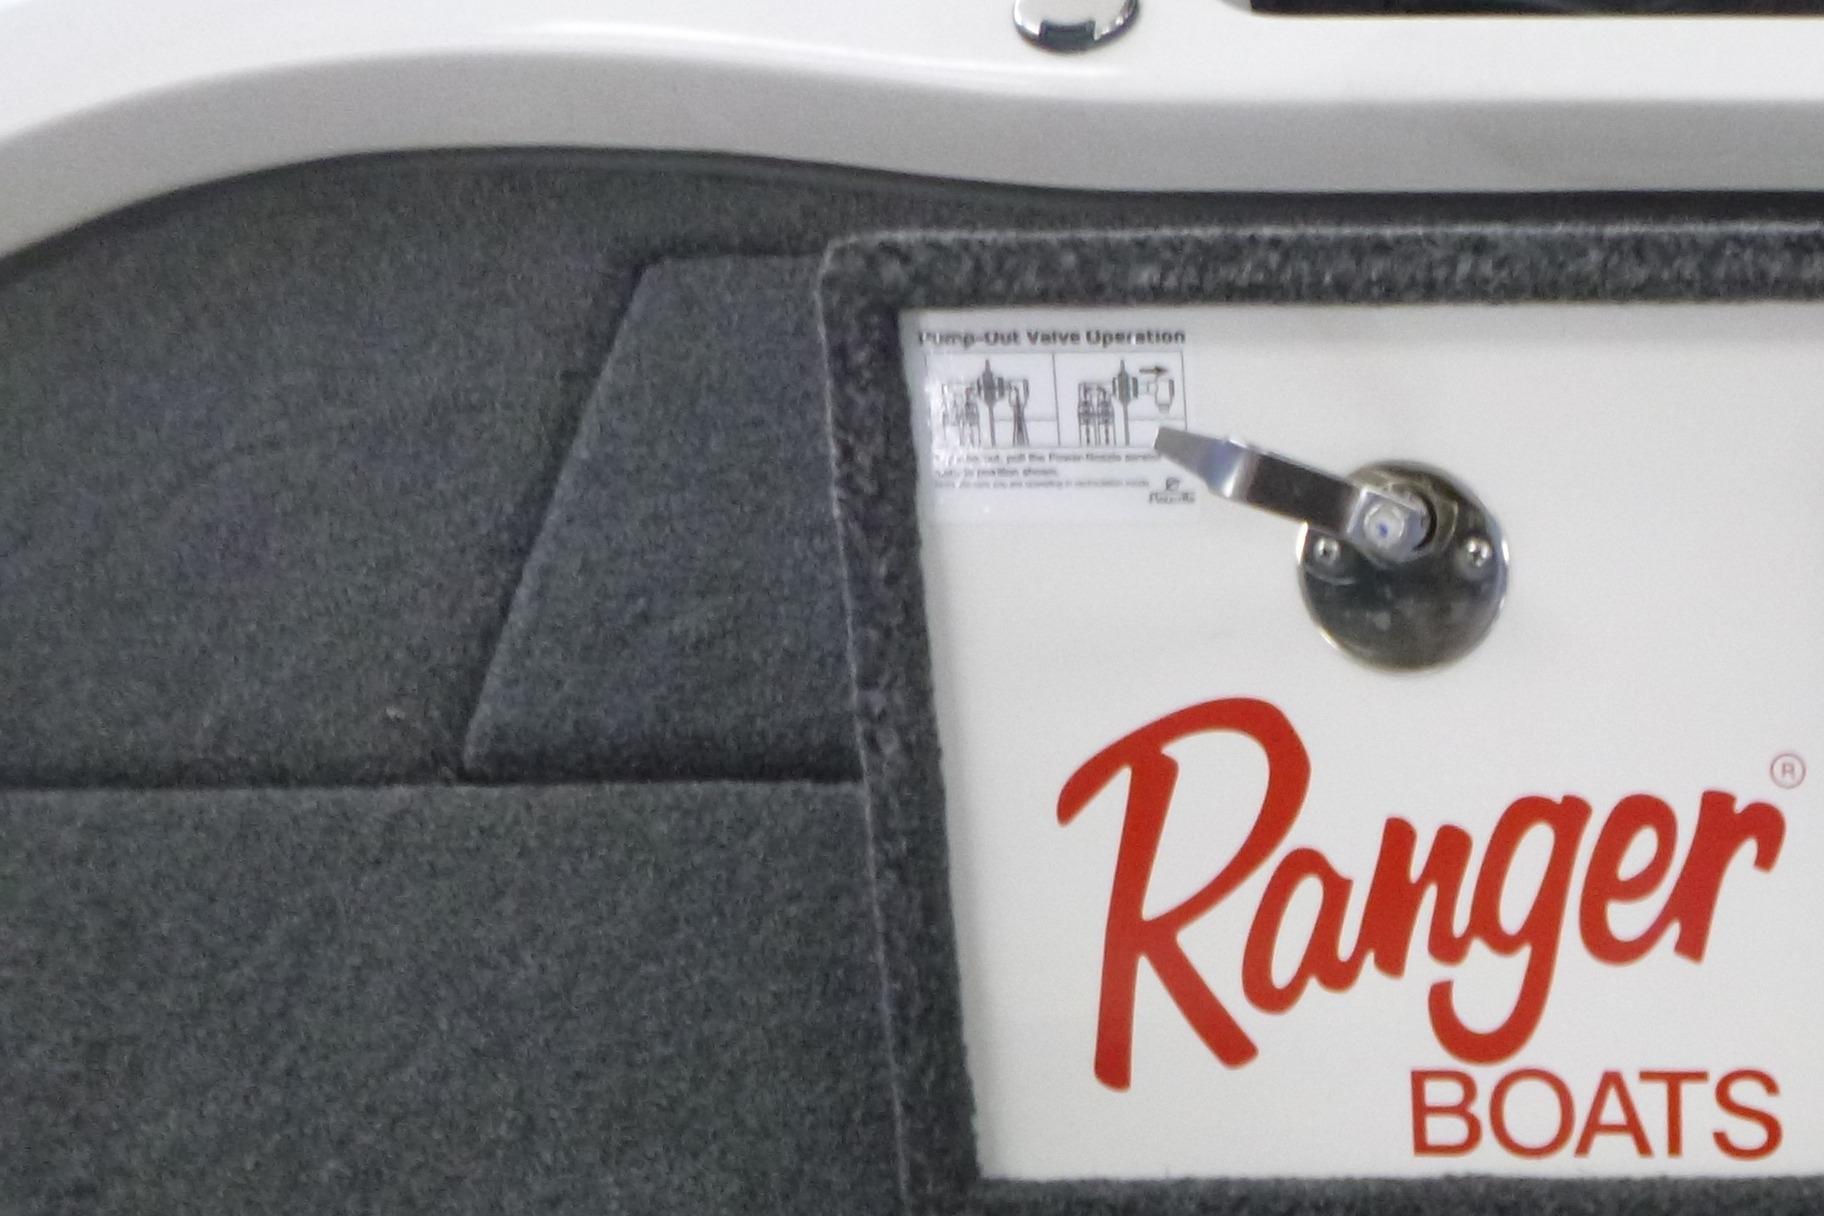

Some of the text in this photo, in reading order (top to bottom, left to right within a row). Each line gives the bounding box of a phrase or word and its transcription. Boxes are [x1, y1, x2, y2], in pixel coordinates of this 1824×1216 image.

[1027, 330, 1081, 345] Valve
[1085, 330, 1186, 348] Operation
[1057, 697, 1786, 1091] Ranger
[1411, 1068, 1782, 1160] BOATS
